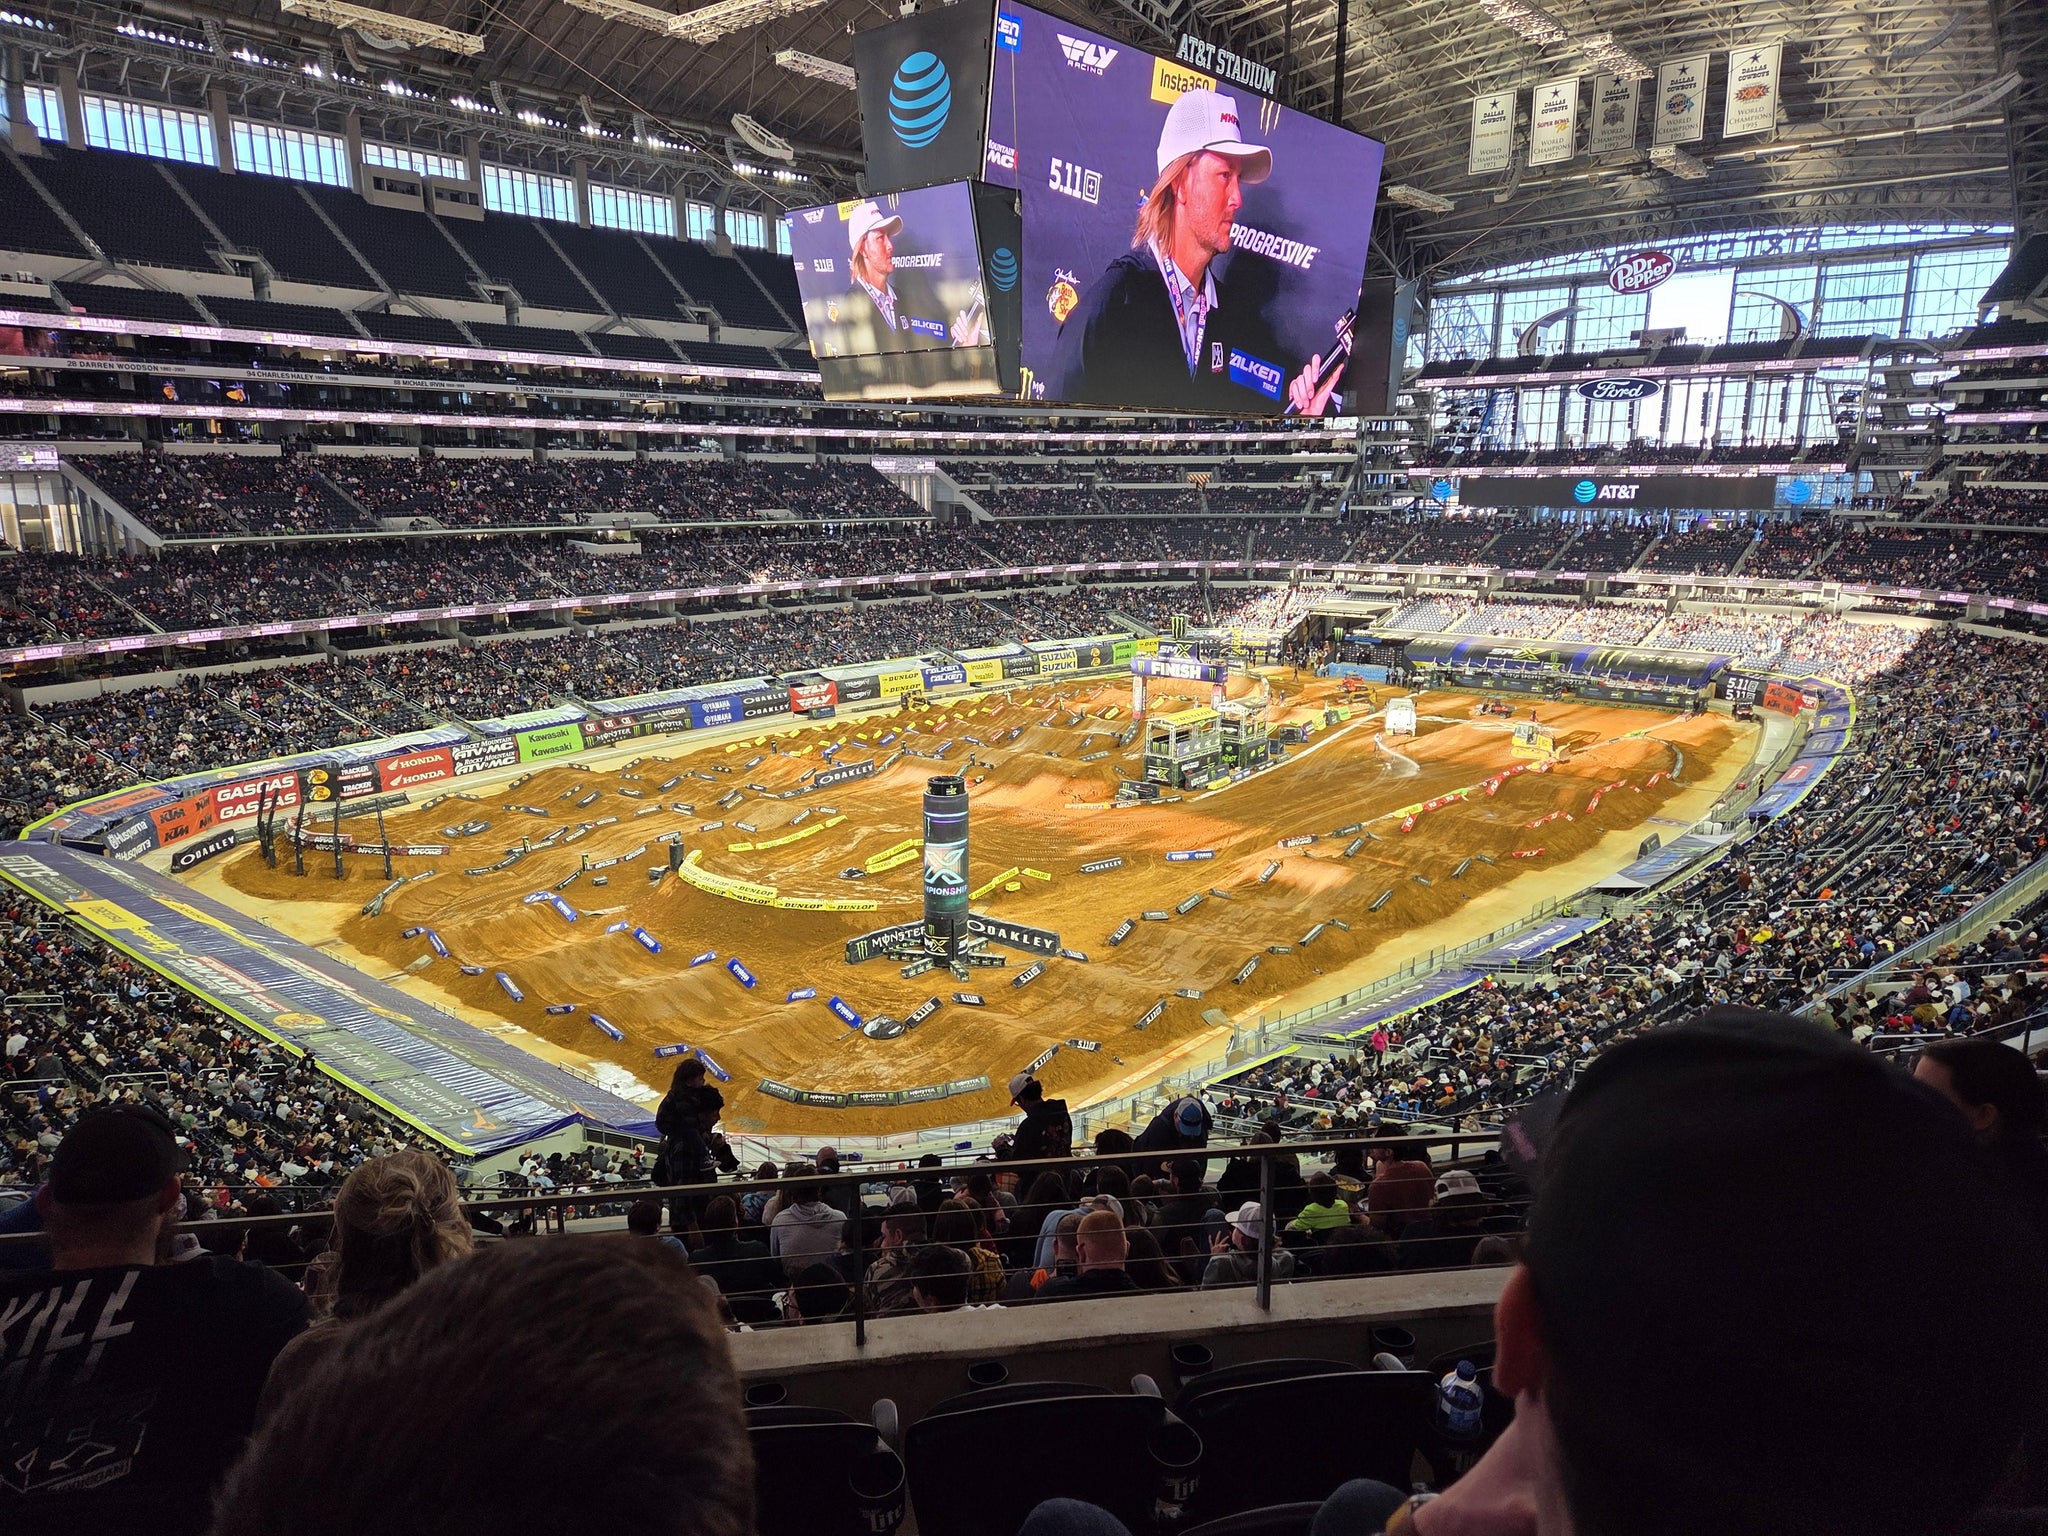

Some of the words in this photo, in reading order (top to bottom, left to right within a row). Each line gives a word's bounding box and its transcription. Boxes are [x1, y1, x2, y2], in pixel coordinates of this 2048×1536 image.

[1067, 60, 1103, 75] RACING
[1175, 33, 1216, 69] AT&T
[1215, 50, 1278, 94] STADIUM
[1742, 64, 1767, 74] DALLAS
[1670, 76, 1694, 85] DALLAS
[1738, 70, 1770, 81] COWBOYS
[1605, 87, 1628, 96] DALLAS
[1667, 82, 1696, 92] COWBOYS
[1544, 99, 1566, 108] DALLAS
[1602, 94, 1630, 103] COWBOYS
[1483, 110, 1504, 118] DALLAS
[1541, 105, 1568, 114] COWBOYS
[1737, 106, 1764, 116] WORLD
[1481, 116, 1506, 125] COWBOYS
[1666, 117, 1691, 126] WORLD
[1729, 112, 1772, 125] CHAMPIONS
[1601, 127, 1624, 136] WORLD
[1657, 123, 1699, 134] CHAMPIONS
[1541, 138, 1564, 146] WORLD
[1593, 134, 1631, 144] CHAMPIONS
[1480, 148, 1502, 156] WORLD
[1533, 144, 1571, 155] CHAMPIONS
[1473, 154, 1509, 163] CHAMPIONS
[1049, 157, 1082, 199] 5.11
[1229, 223, 1317, 269] PROGRESSIVE
[892, 253, 942, 268] PROGRESSIVE
[1632, 256, 1656, 275] Dr
[1617, 261, 1672, 291] Pepper
[81, 318, 126, 329] MILITARY
[181, 326, 223, 336] MILITARY
[273, 332, 312, 343] MILITARY
[358, 340, 392, 350] MILITARY
[436, 347, 468, 355] MILITARY
[1975, 348, 2012, 358] MILITARY
[79, 361, 114, 369] DARREN
[116, 363, 159, 372] WOODSON
[1765, 360, 1795, 368] MILITARY
[257, 371, 289, 379] CHARLES
[1592, 380, 1644, 399] Ford
[63, 402, 94, 411] MILITARY
[132, 404, 160, 413] MILITARY
[196, 407, 223, 415] MILITARY
[1599, 484, 1640, 499] AT&T
[391, 612, 418, 622] MILITARY
[451, 607, 476, 617] MILITARY
[329, 618, 357, 627] MILITARY
[261, 624, 292, 634] MILITARY
[188, 631, 222, 641] MILITARY
[110, 638, 145, 649] MILITARY
[24, 646, 63, 658] MILITARY
[1160, 643, 1192, 658] SMX
[1041, 652, 1076, 664] SUZUKI
[924, 664, 959, 675] FALKEN
[1041, 661, 1076, 673] SUZUKI
[1151, 662, 1201, 680] FINISH
[888, 672, 919, 682] DUNLOP
[930, 672, 963, 683] FALKEN
[889, 683, 921, 693] DUNLOP
[1727, 678, 1749, 690] 5.11
[754, 691, 788, 704] OAKLEY
[709, 700, 731, 711] YAMAHA
[757, 704, 790, 717] OAKLEY
[662, 707, 686, 717] amazon
[711, 712, 732, 723] YAMAHA
[654, 720, 684, 730] MONSTER
[528, 729, 570, 743] Kawasaki
[596, 728, 631, 742] MONSTER
[461, 740, 481, 751] ROCKY
[481, 736, 512, 747] MOUNTAIN
[531, 743, 573, 757] Kawasaki
[400, 754, 444, 768] HONDA
[463, 756, 482, 768] ROCKY
[483, 752, 515, 763] MOUNTAIN
[341, 765, 370, 776] TRACKER
[833, 763, 874, 781] OAKLEY
[403, 769, 446, 784] HONDA
[217, 775, 296, 802] GASGAS
[343, 780, 373, 794] TRACKER
[219, 792, 296, 819] GASGAS
[160, 808, 186, 825] KTM
[116, 820, 148, 846] Husqvarna
[164, 825, 190, 843] KTM
[195, 835, 235, 860] OAKLEY
[1094, 858, 1123, 871] OAKLEY
[738, 885, 774, 897] DUNLOP
[784, 902, 823, 910] DUNLOP
[837, 903, 875, 911] DUNLOP
[987, 925, 1055, 950] OAKLEY
[912, 1007, 929, 1022] 5.11
[768, 1083, 790, 1094] MONSTER
[956, 1078, 981, 1088] MONSTER
[388, 1080, 427, 1103] SPORTS
[405, 1077, 468, 1115] COMMISSION
[809, 1092, 836, 1102] MONSTER
[859, 1092, 887, 1100] MONSTER
[909, 1087, 936, 1098] MONSTER
[429, 1101, 452, 1118] UTAH
